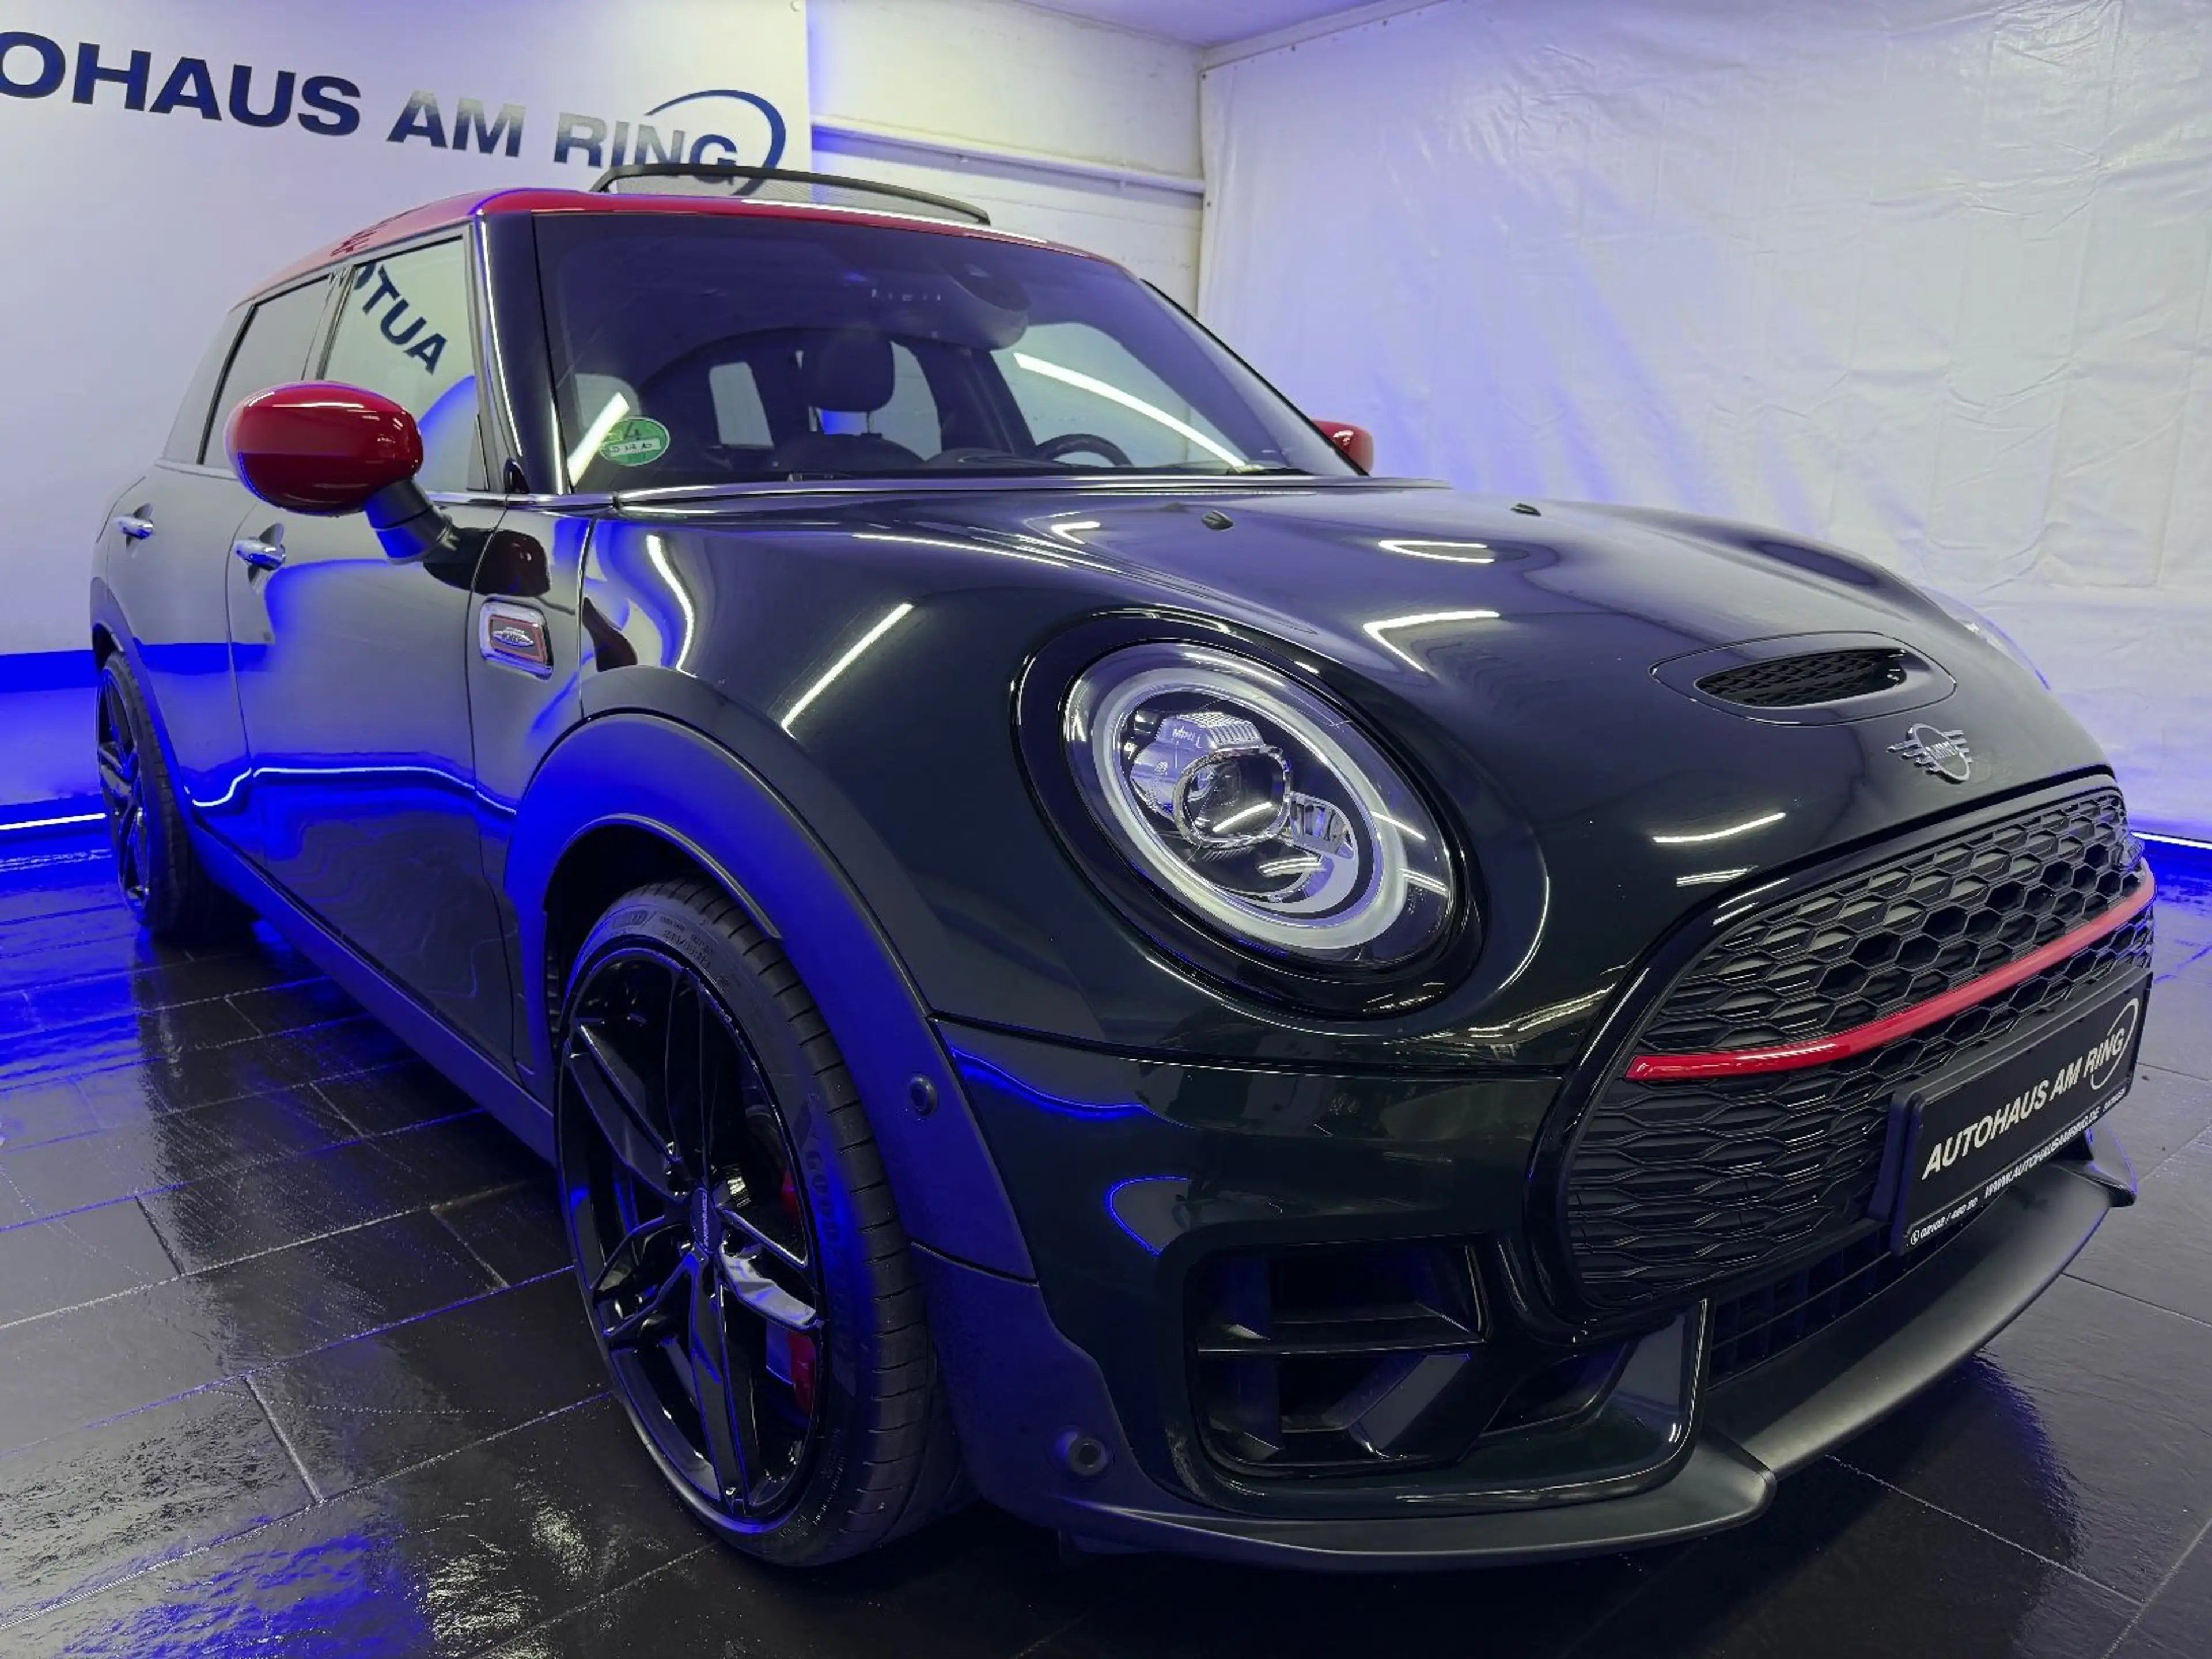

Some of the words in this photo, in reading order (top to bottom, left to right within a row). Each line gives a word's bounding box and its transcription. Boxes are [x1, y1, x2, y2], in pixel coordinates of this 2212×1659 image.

[385, 89, 527, 158] AM
[553, 112, 737, 186] RING
[1921, 1079, 2050, 1180] AUTOHAUS
[2049, 1056, 2083, 1101] AM
[2082, 1027, 2126, 1078] RING
